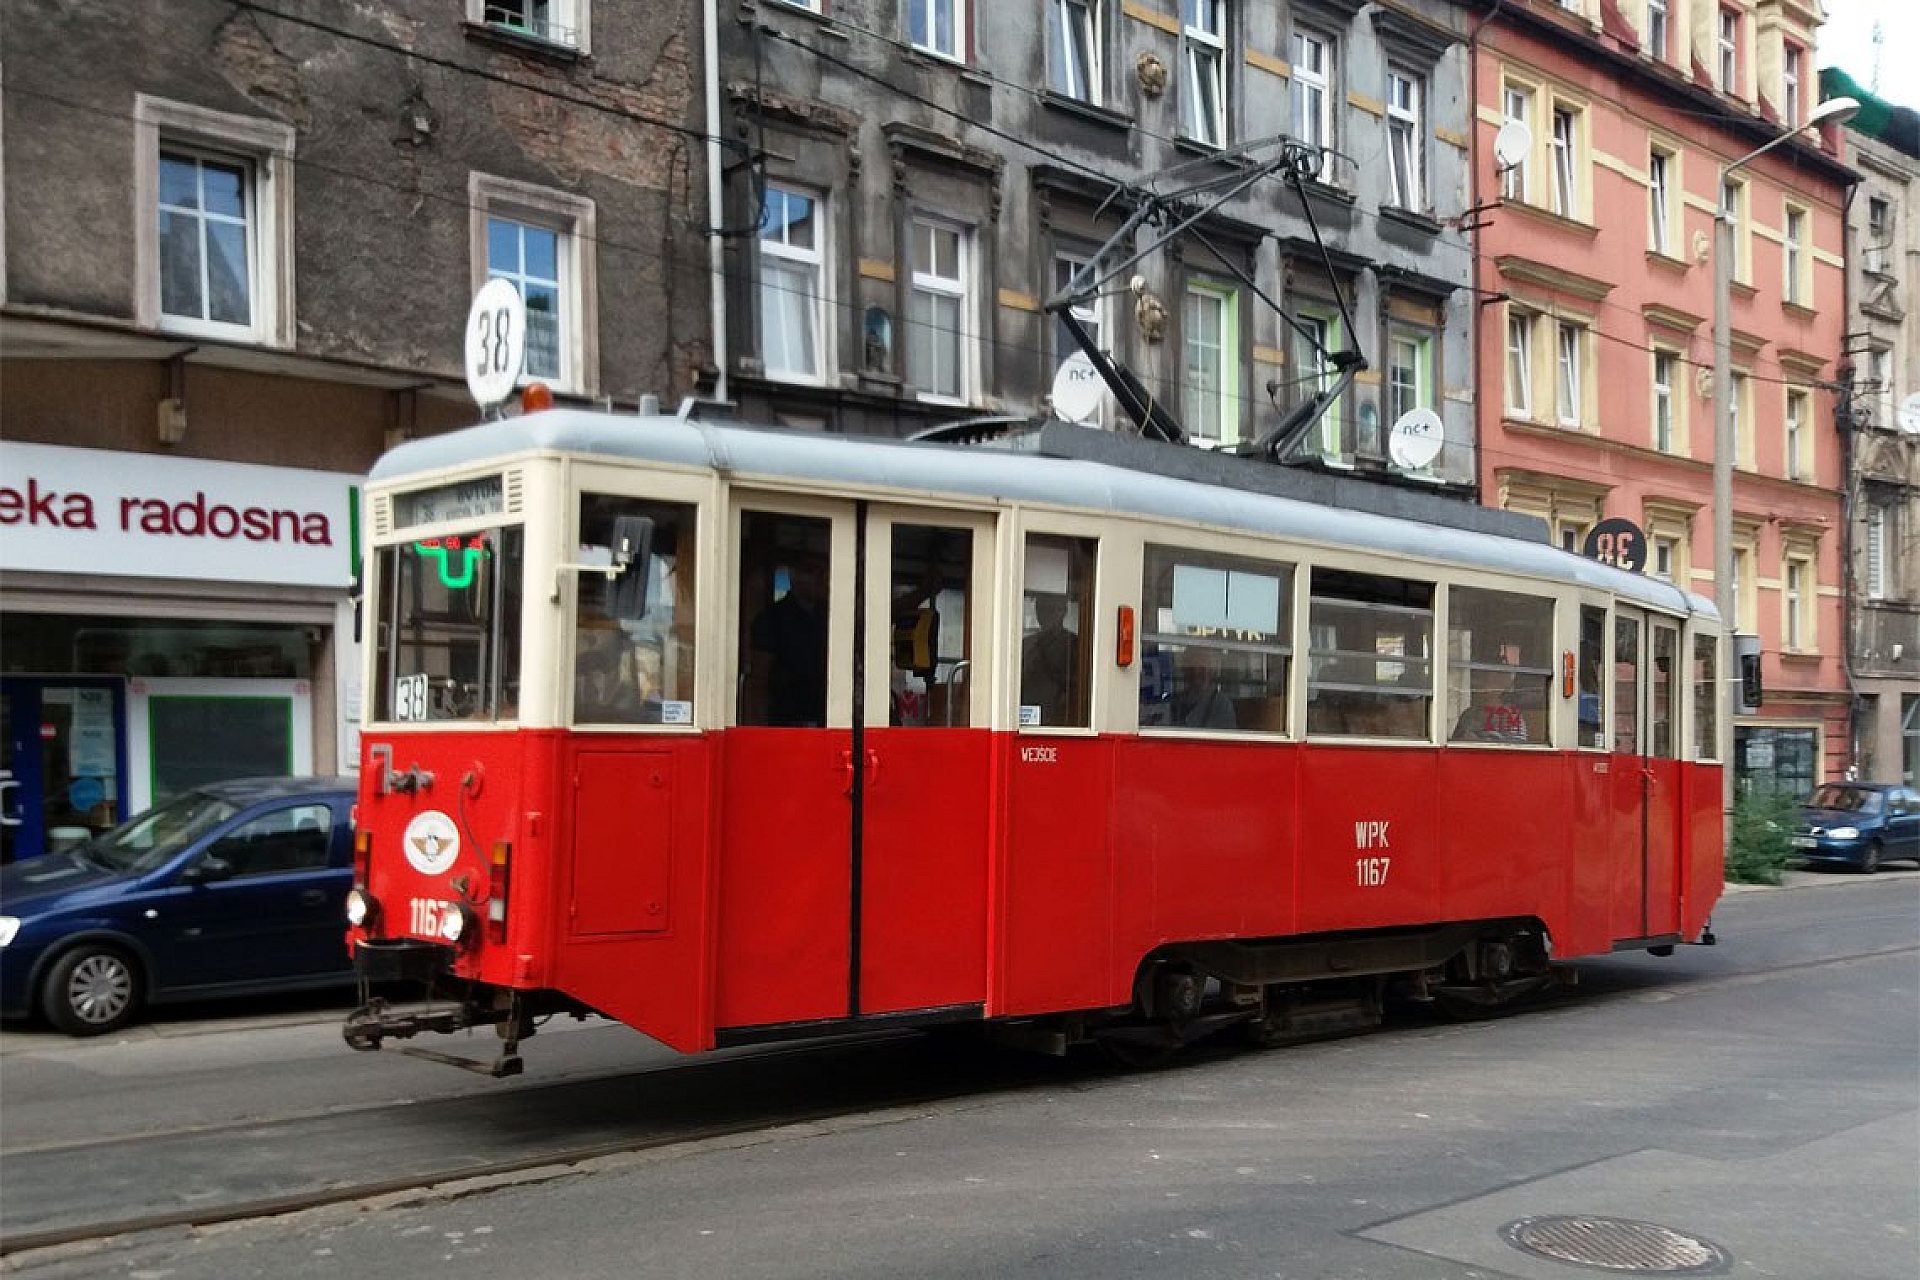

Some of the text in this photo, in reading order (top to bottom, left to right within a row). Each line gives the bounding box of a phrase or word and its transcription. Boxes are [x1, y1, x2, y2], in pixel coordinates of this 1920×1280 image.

[478, 307, 510, 376] 38
[1402, 423, 1430, 435] nc+
[0, 477, 333, 547] eka radosna
[399, 677, 425, 720] 38
[1355, 821, 1389, 849] WPK
[1356, 858, 1390, 887] 1167
[409, 898, 448, 937] 1167
